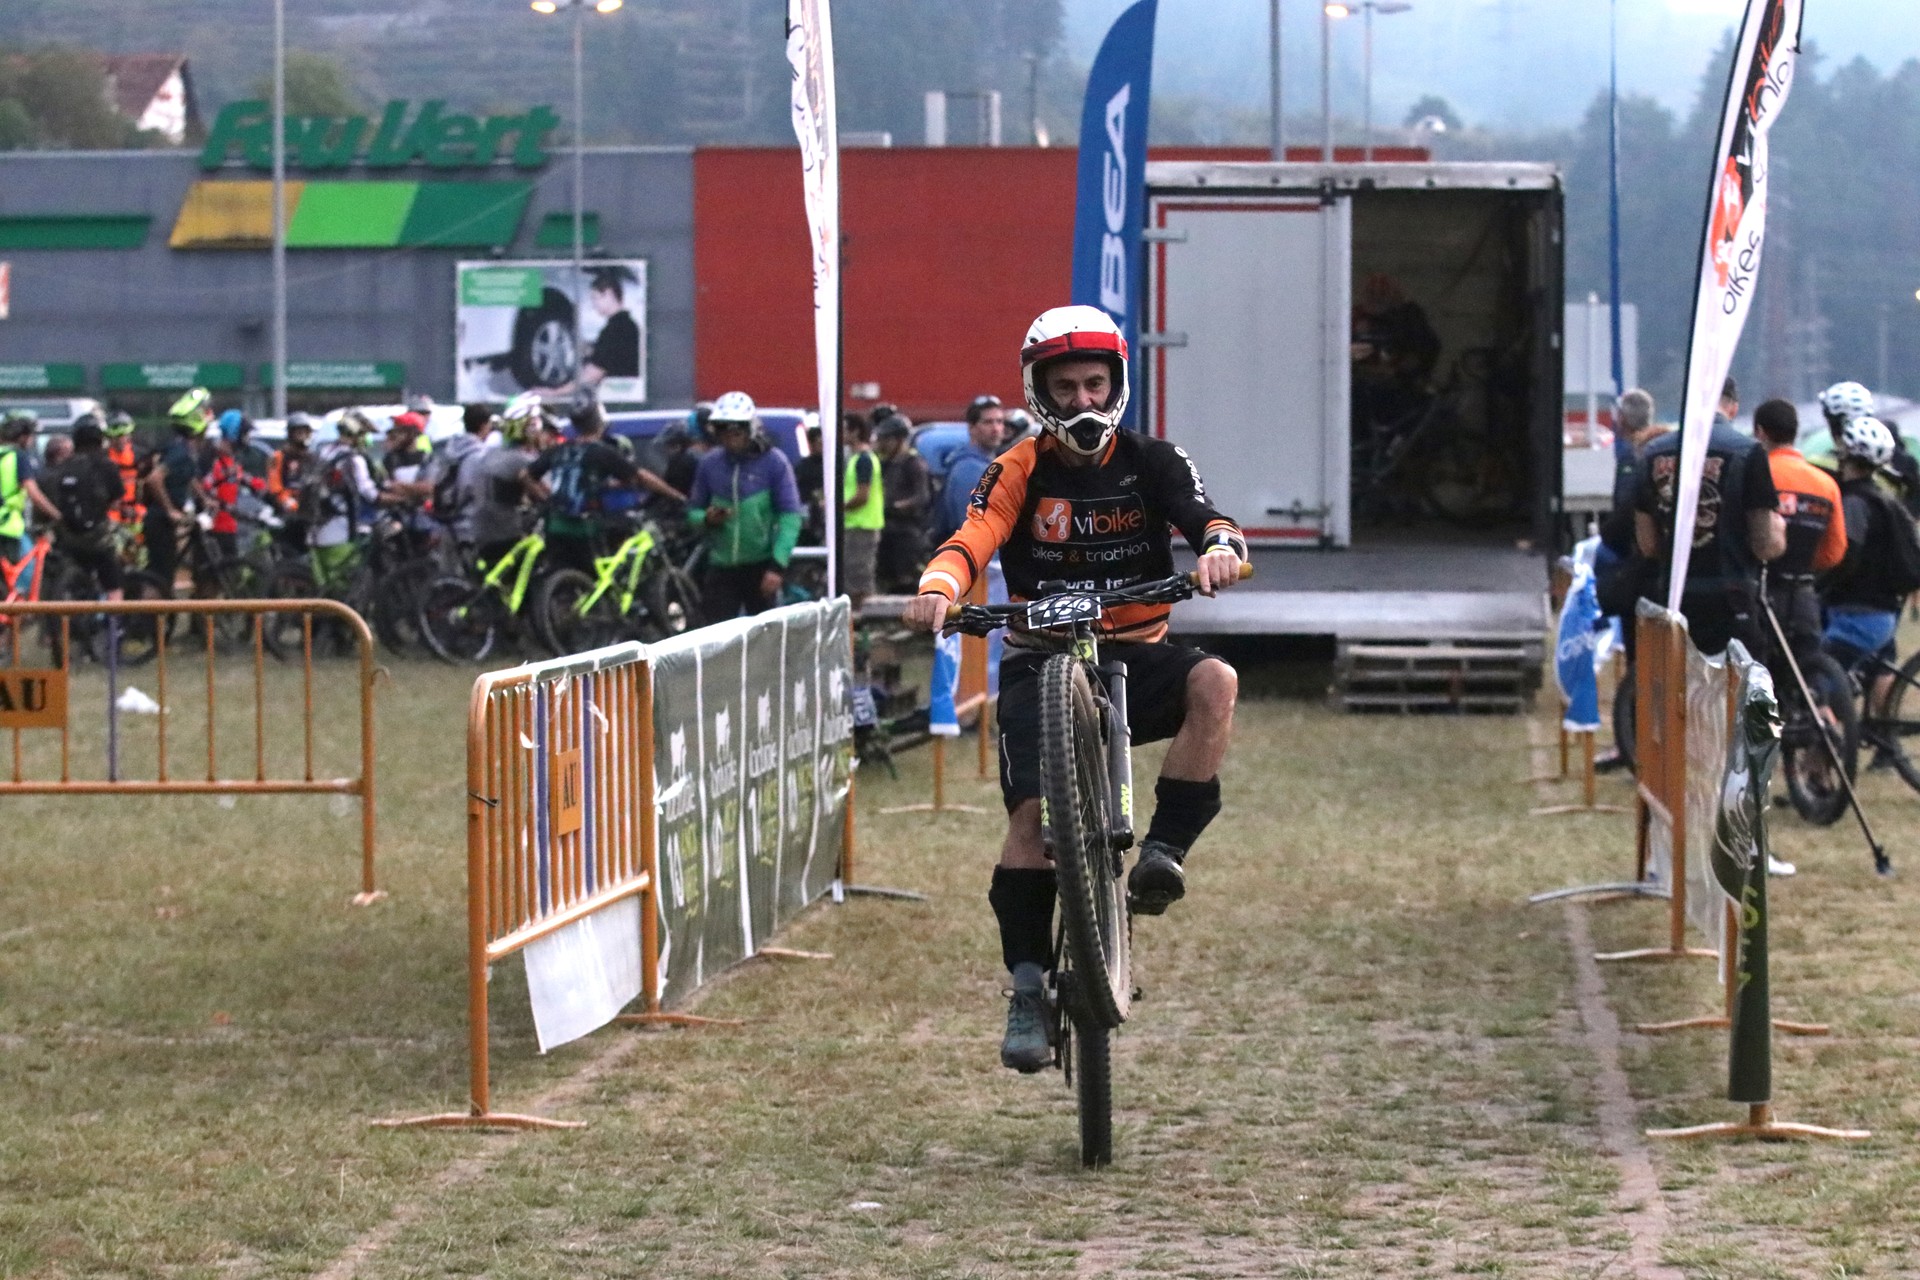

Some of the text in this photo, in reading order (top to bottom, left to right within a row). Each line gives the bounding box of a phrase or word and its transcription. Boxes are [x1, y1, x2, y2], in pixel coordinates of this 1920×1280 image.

[1074, 506, 1143, 535] vibike
[1033, 545, 1063, 561] bikes
[1086, 541, 1150, 562] triathlon
